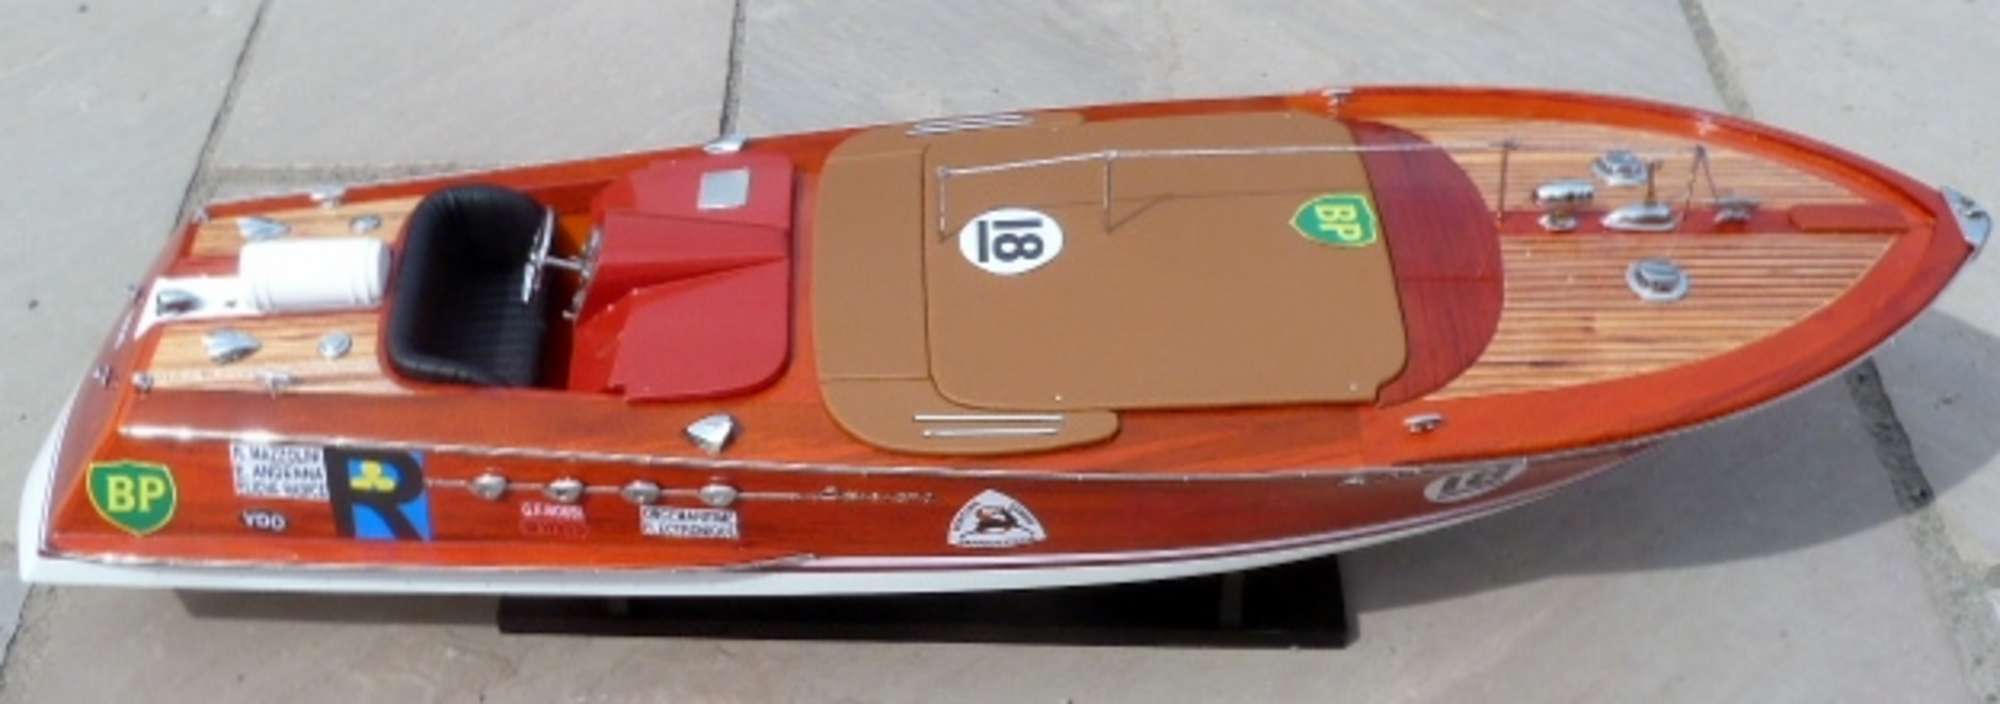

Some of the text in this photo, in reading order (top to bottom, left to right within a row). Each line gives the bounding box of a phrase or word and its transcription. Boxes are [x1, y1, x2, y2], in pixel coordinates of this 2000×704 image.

[992, 217, 1044, 262] 18
[1314, 204, 1364, 240] BP
[107, 475, 166, 514] BP
